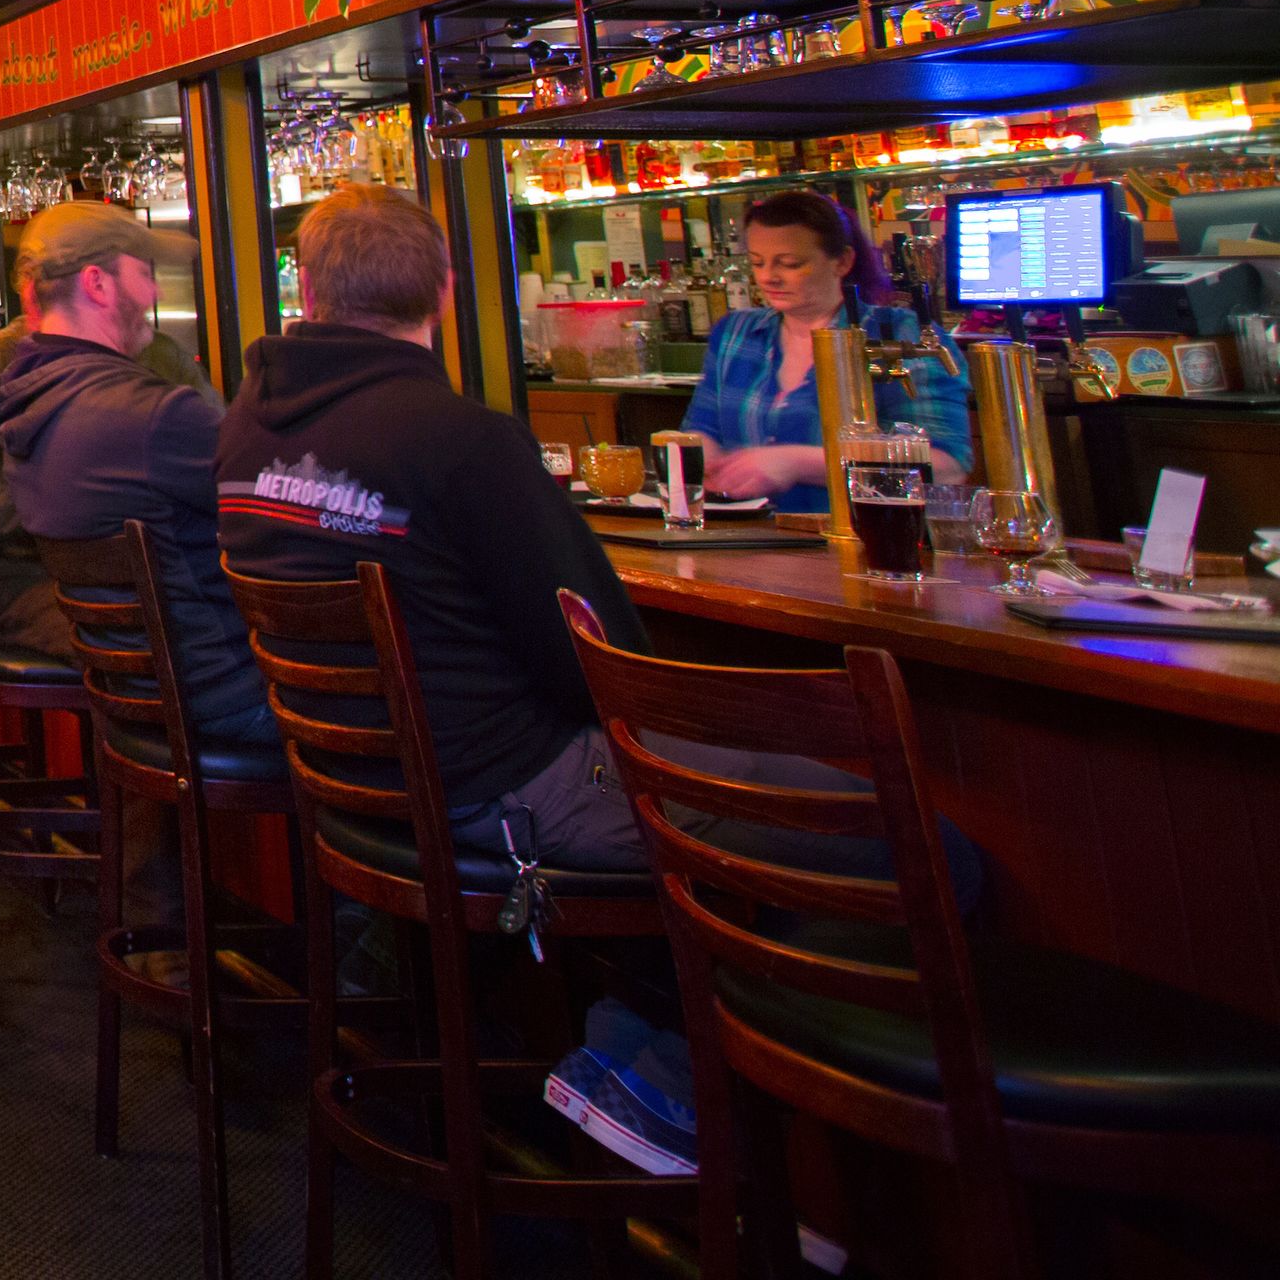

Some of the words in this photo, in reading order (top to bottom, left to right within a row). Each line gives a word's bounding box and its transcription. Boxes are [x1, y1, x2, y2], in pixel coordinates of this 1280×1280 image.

[2, 36, 58, 84] about
[72, 16, 152, 80] music,
[254, 471, 385, 521] METROPOLIS
